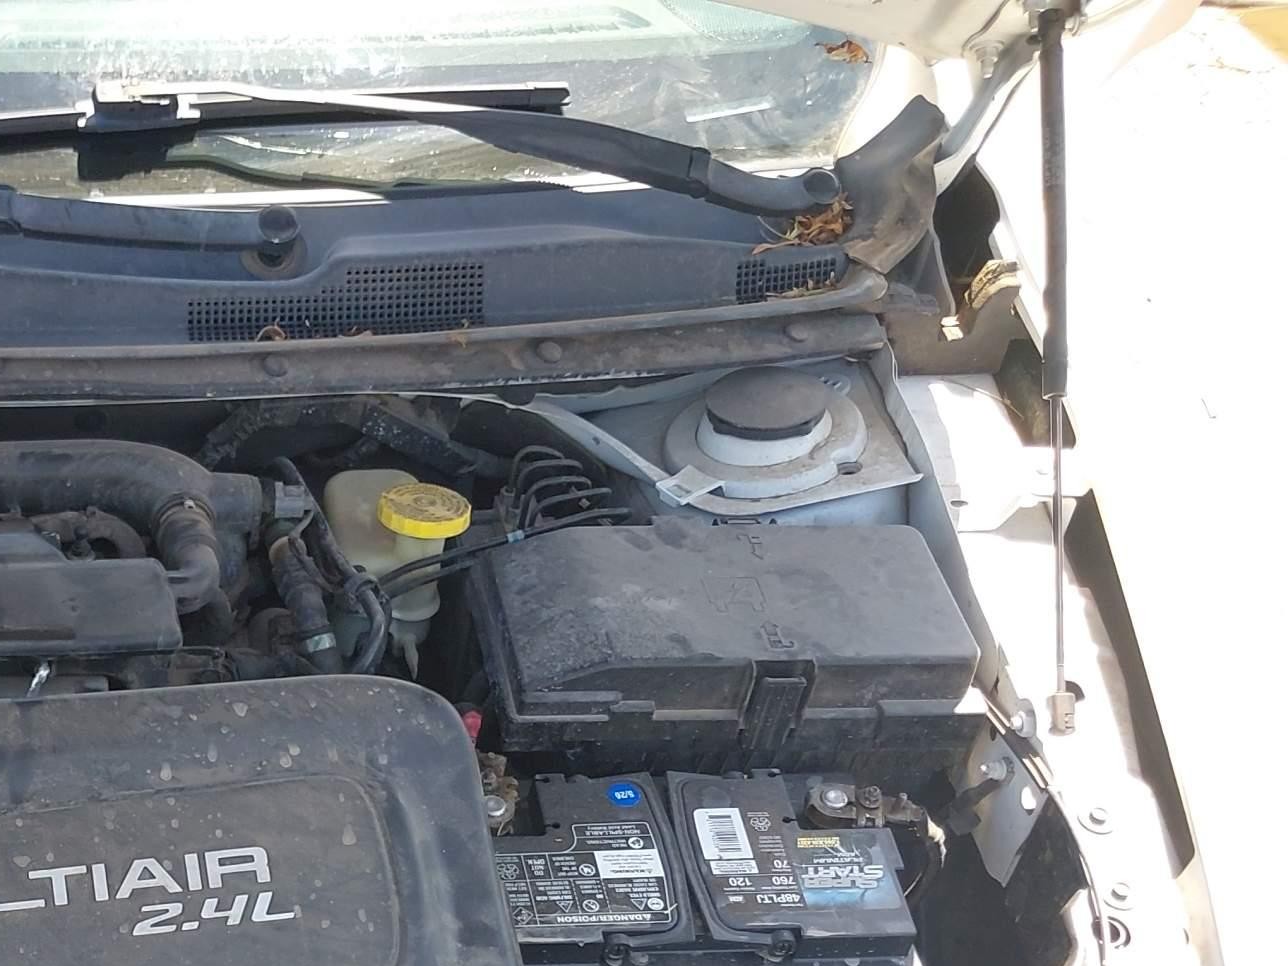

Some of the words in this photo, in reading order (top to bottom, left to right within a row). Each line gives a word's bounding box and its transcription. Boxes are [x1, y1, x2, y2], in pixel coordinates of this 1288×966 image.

[773, 859, 791, 868] 70
[801, 865, 883, 878] START
[728, 877, 752, 885] 120
[772, 876, 796, 885] 760
[804, 877, 877, 888] SUPER
[756, 893, 801, 903] 48PLTJ
[132, 892, 297, 936] 2.4L
[556, 914, 643, 923] DANGER/POISON
